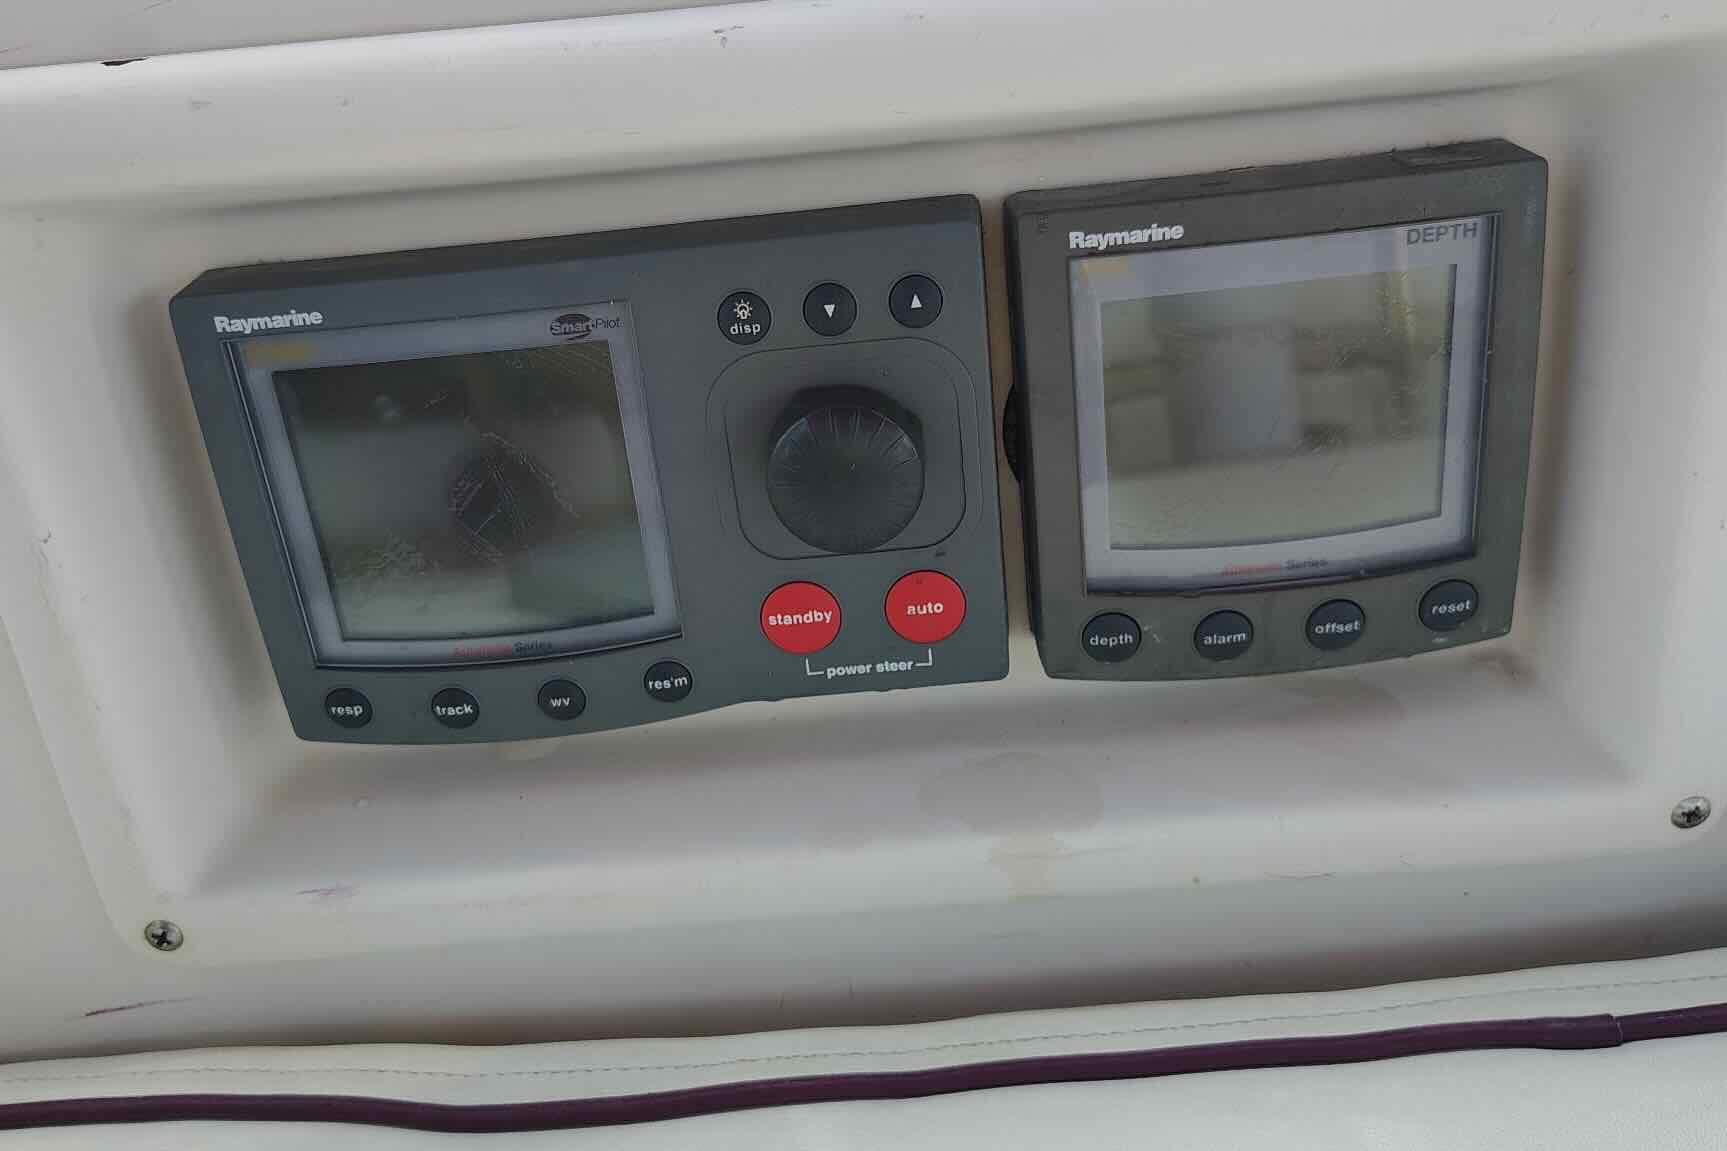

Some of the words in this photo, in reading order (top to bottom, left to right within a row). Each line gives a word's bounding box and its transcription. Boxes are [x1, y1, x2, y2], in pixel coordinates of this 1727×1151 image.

[1069, 223, 1185, 251] Raymarine
[1406, 222, 1478, 245] DEPTH
[214, 310, 323, 335] Raymarine
[729, 321, 761, 336] disp
[906, 600, 944, 616] auto
[1431, 599, 1471, 614] reset
[768, 608, 832, 627] standby
[1315, 619, 1360, 635] offset
[1089, 631, 1133, 648] depth
[1204, 628, 1246, 645] alarm
[826, 663, 872, 680] power
[876, 659, 915, 673] steer
[647, 675, 689, 690] res'm
[435, 702, 474, 717] track
[550, 696, 571, 708] wv
[331, 703, 363, 719] resp
